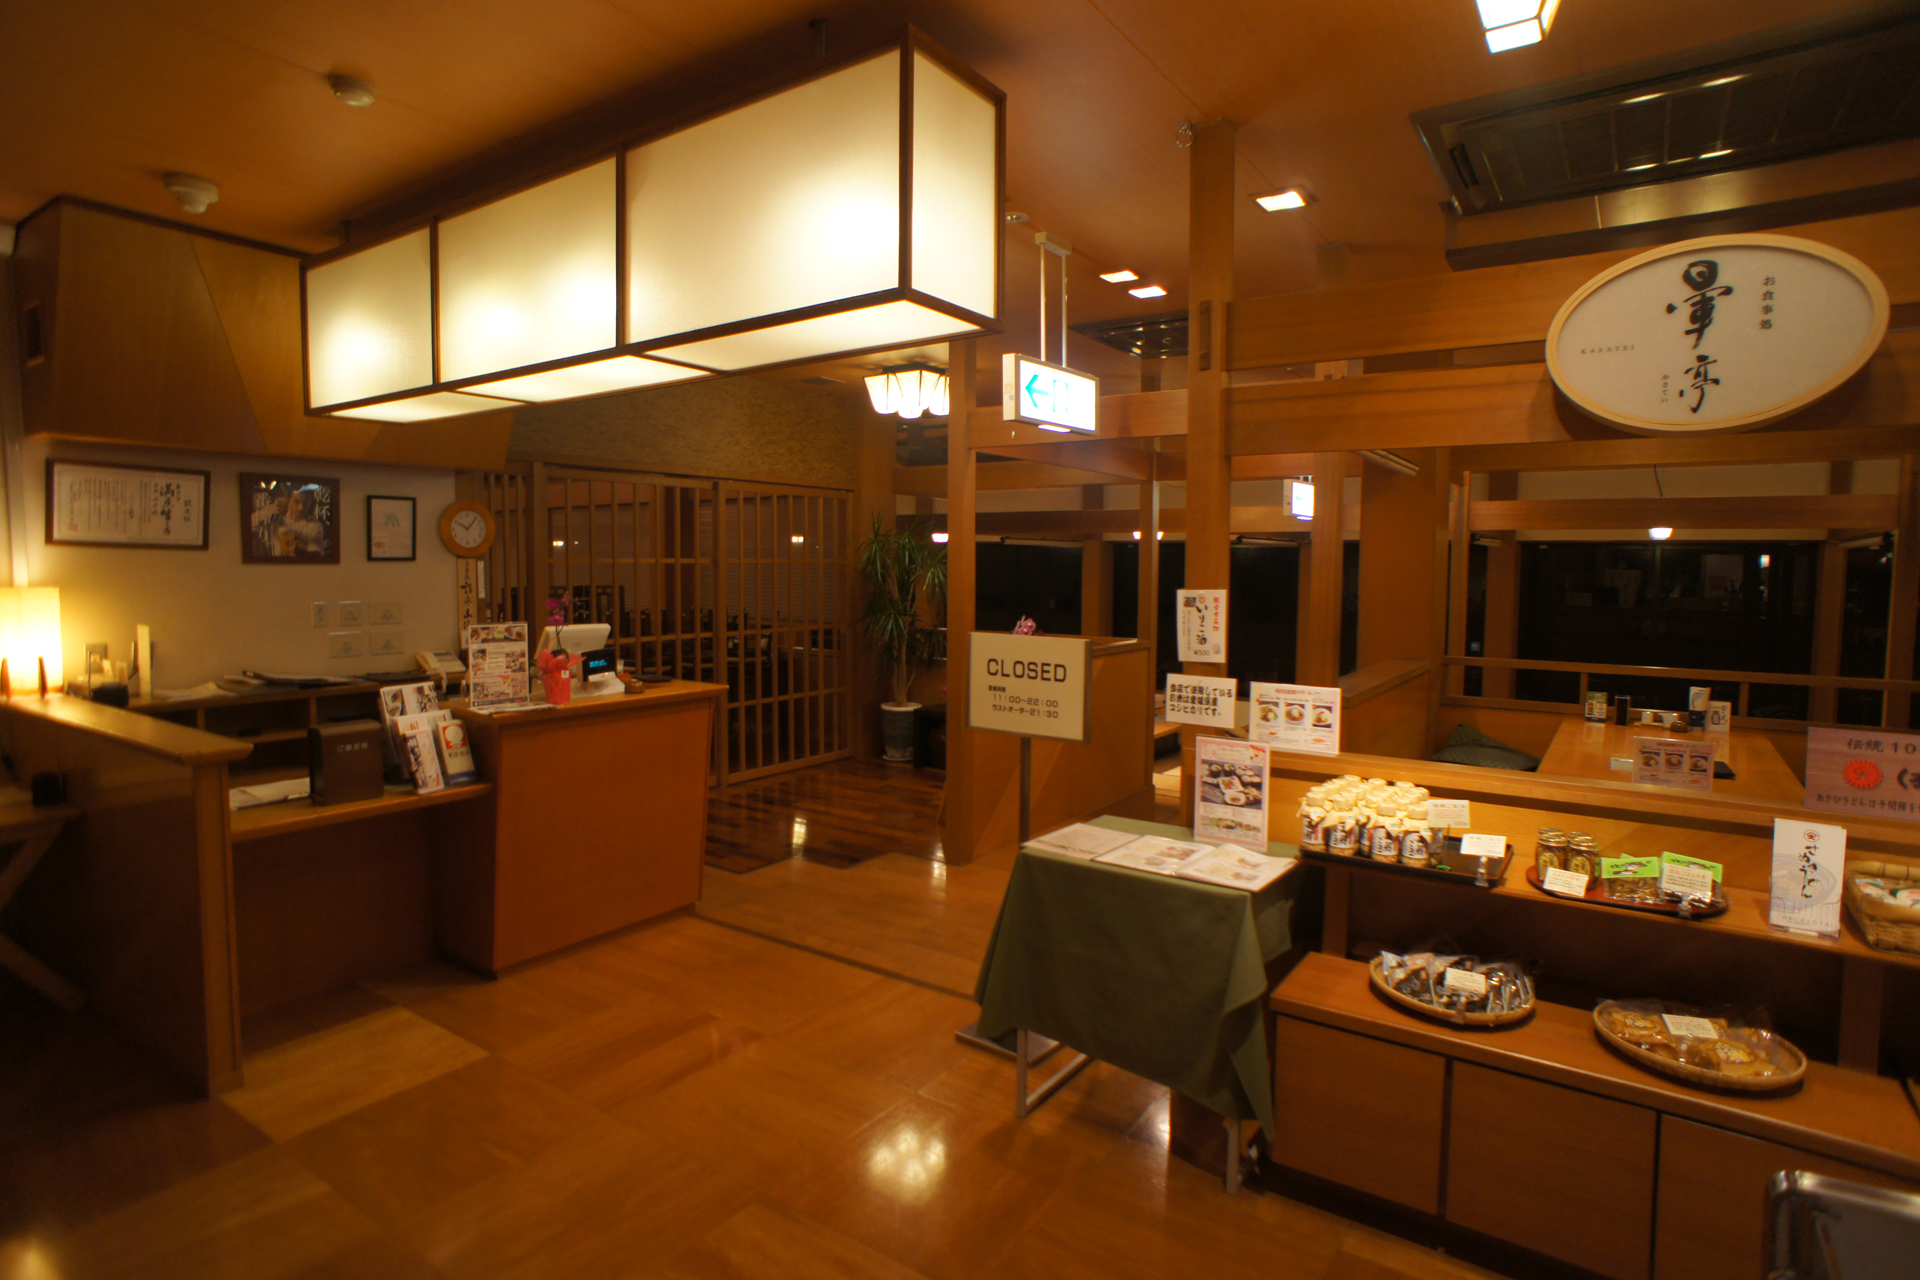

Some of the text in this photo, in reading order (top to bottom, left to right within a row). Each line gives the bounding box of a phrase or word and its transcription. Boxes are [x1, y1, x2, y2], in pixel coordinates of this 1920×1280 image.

[1759, 276, 1775, 330] お食事処
[1580, 344, 1634, 355] KASATEI
[1660, 373, 1670, 403] かさてい
[1195, 604, 1208, 645] いりこ酒
[987, 658, 1067, 684] CLOSED
[1170, 683, 1233, 698] 当店で使用している
[1169, 703, 1222, 717] コシヒカリです。
